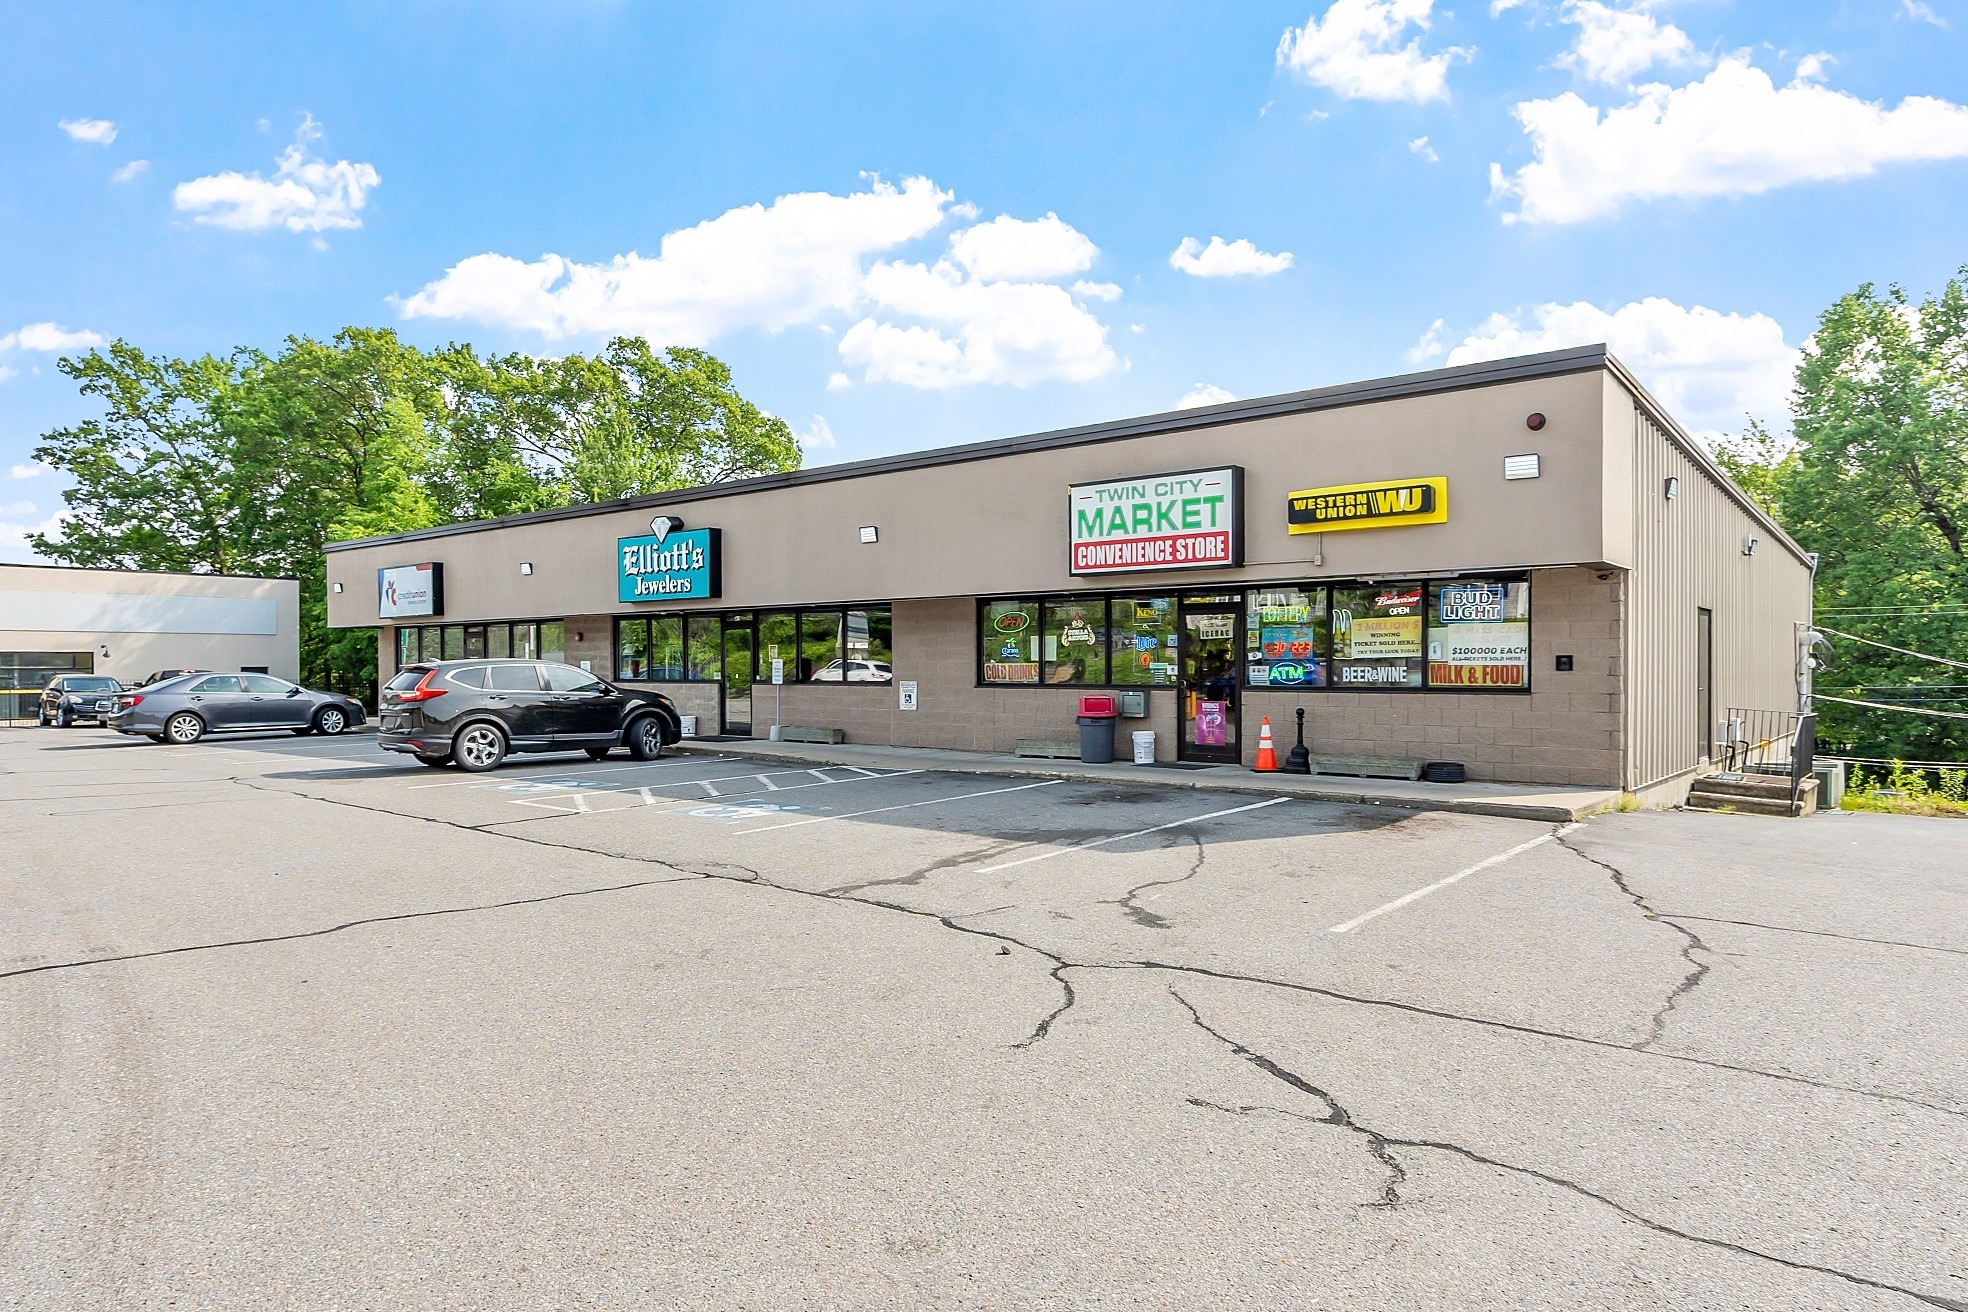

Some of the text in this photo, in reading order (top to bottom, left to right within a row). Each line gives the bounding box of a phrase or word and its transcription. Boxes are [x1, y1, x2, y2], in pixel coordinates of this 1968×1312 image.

[1095, 478, 1203, 503] TWIN CITY
[1293, 493, 1367, 511] WESTERN
[1376, 487, 1423, 514] WU
[1077, 494, 1225, 539] MARKET
[1316, 504, 1367, 519] UNION
[622, 538, 704, 576] Elliott's
[1077, 535, 1225, 567] CONVENIENCE STORE
[634, 574, 692, 595] Jewelers
[1375, 595, 1420, 607] Budweiser
[1451, 590, 1493, 606] BUD
[1262, 605, 1311, 622] LOTTERY
[1389, 606, 1410, 616] OPEN
[1443, 605, 1500, 620] LIGHT
[998, 615, 1025, 628] OPEN
[1365, 620, 1409, 631] MILLION
[1136, 635, 1158, 652] Lite
[1452, 646, 1528, 655] $100000 EACH
[985, 663, 1039, 680] COLD DRINKS
[1269, 666, 1304, 680] ATM
[1430, 663, 1521, 684] MILK & FOOD
